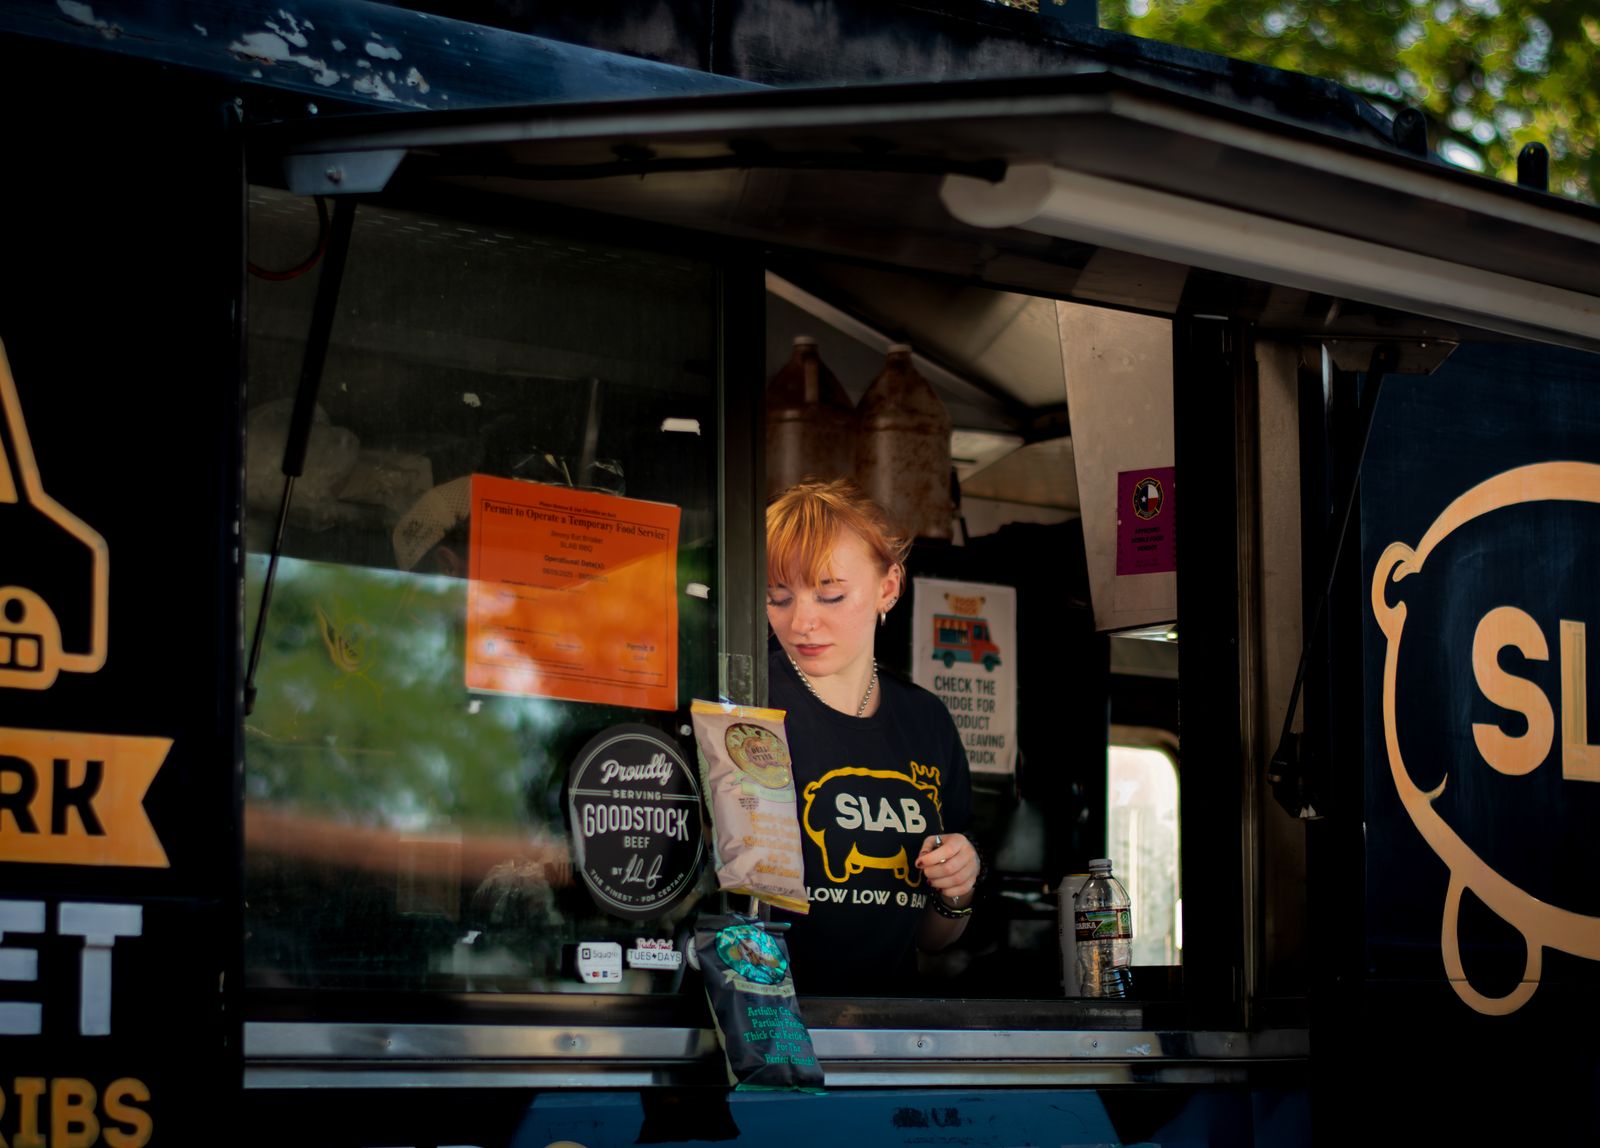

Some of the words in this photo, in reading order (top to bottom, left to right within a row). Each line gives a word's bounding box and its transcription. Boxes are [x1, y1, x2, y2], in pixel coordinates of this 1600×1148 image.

[484, 502, 513, 518] Permit
[516, 507, 524, 517] to
[526, 510, 559, 524] Operate
[568, 516, 614, 534] Temporary
[616, 521, 635, 535] Food
[638, 527, 665, 541] Service
[544, 555, 580, 567] Operational
[934, 676, 972, 693] CHECK
[976, 678, 996, 696] THE
[938, 694, 972, 711] RIDGE
[977, 698, 995, 713] FOR
[953, 714, 990, 730] ODUCT
[966, 733, 1004, 748] LEAVING
[601, 754, 674, 785] Proudly
[612, 790, 662, 800] SERVING
[835, 793, 927, 833] SLAB
[583, 803, 690, 842] GOODSTOCK
[624, 836, 650, 848] BEEF
[612, 867, 622, 876] BY
[590, 868, 604, 886] THE
[604, 885, 633, 902] FINEST
[641, 894, 656, 902] FOR
[658, 872, 684, 898] CERTAIN
[806, 886, 848, 903] LOW
[852, 889, 890, 905] LOW
[630, 951, 652, 960] TUES
[658, 952, 681, 962] DAYS
[747, 1006, 778, 1017] Artfully
[751, 1018, 784, 1029] Partially
[744, 1030, 768, 1042] Thick
[776, 1042, 787, 1052] For
[788, 1042, 801, 1052] The
[0, 1076, 153, 1148] IBS
